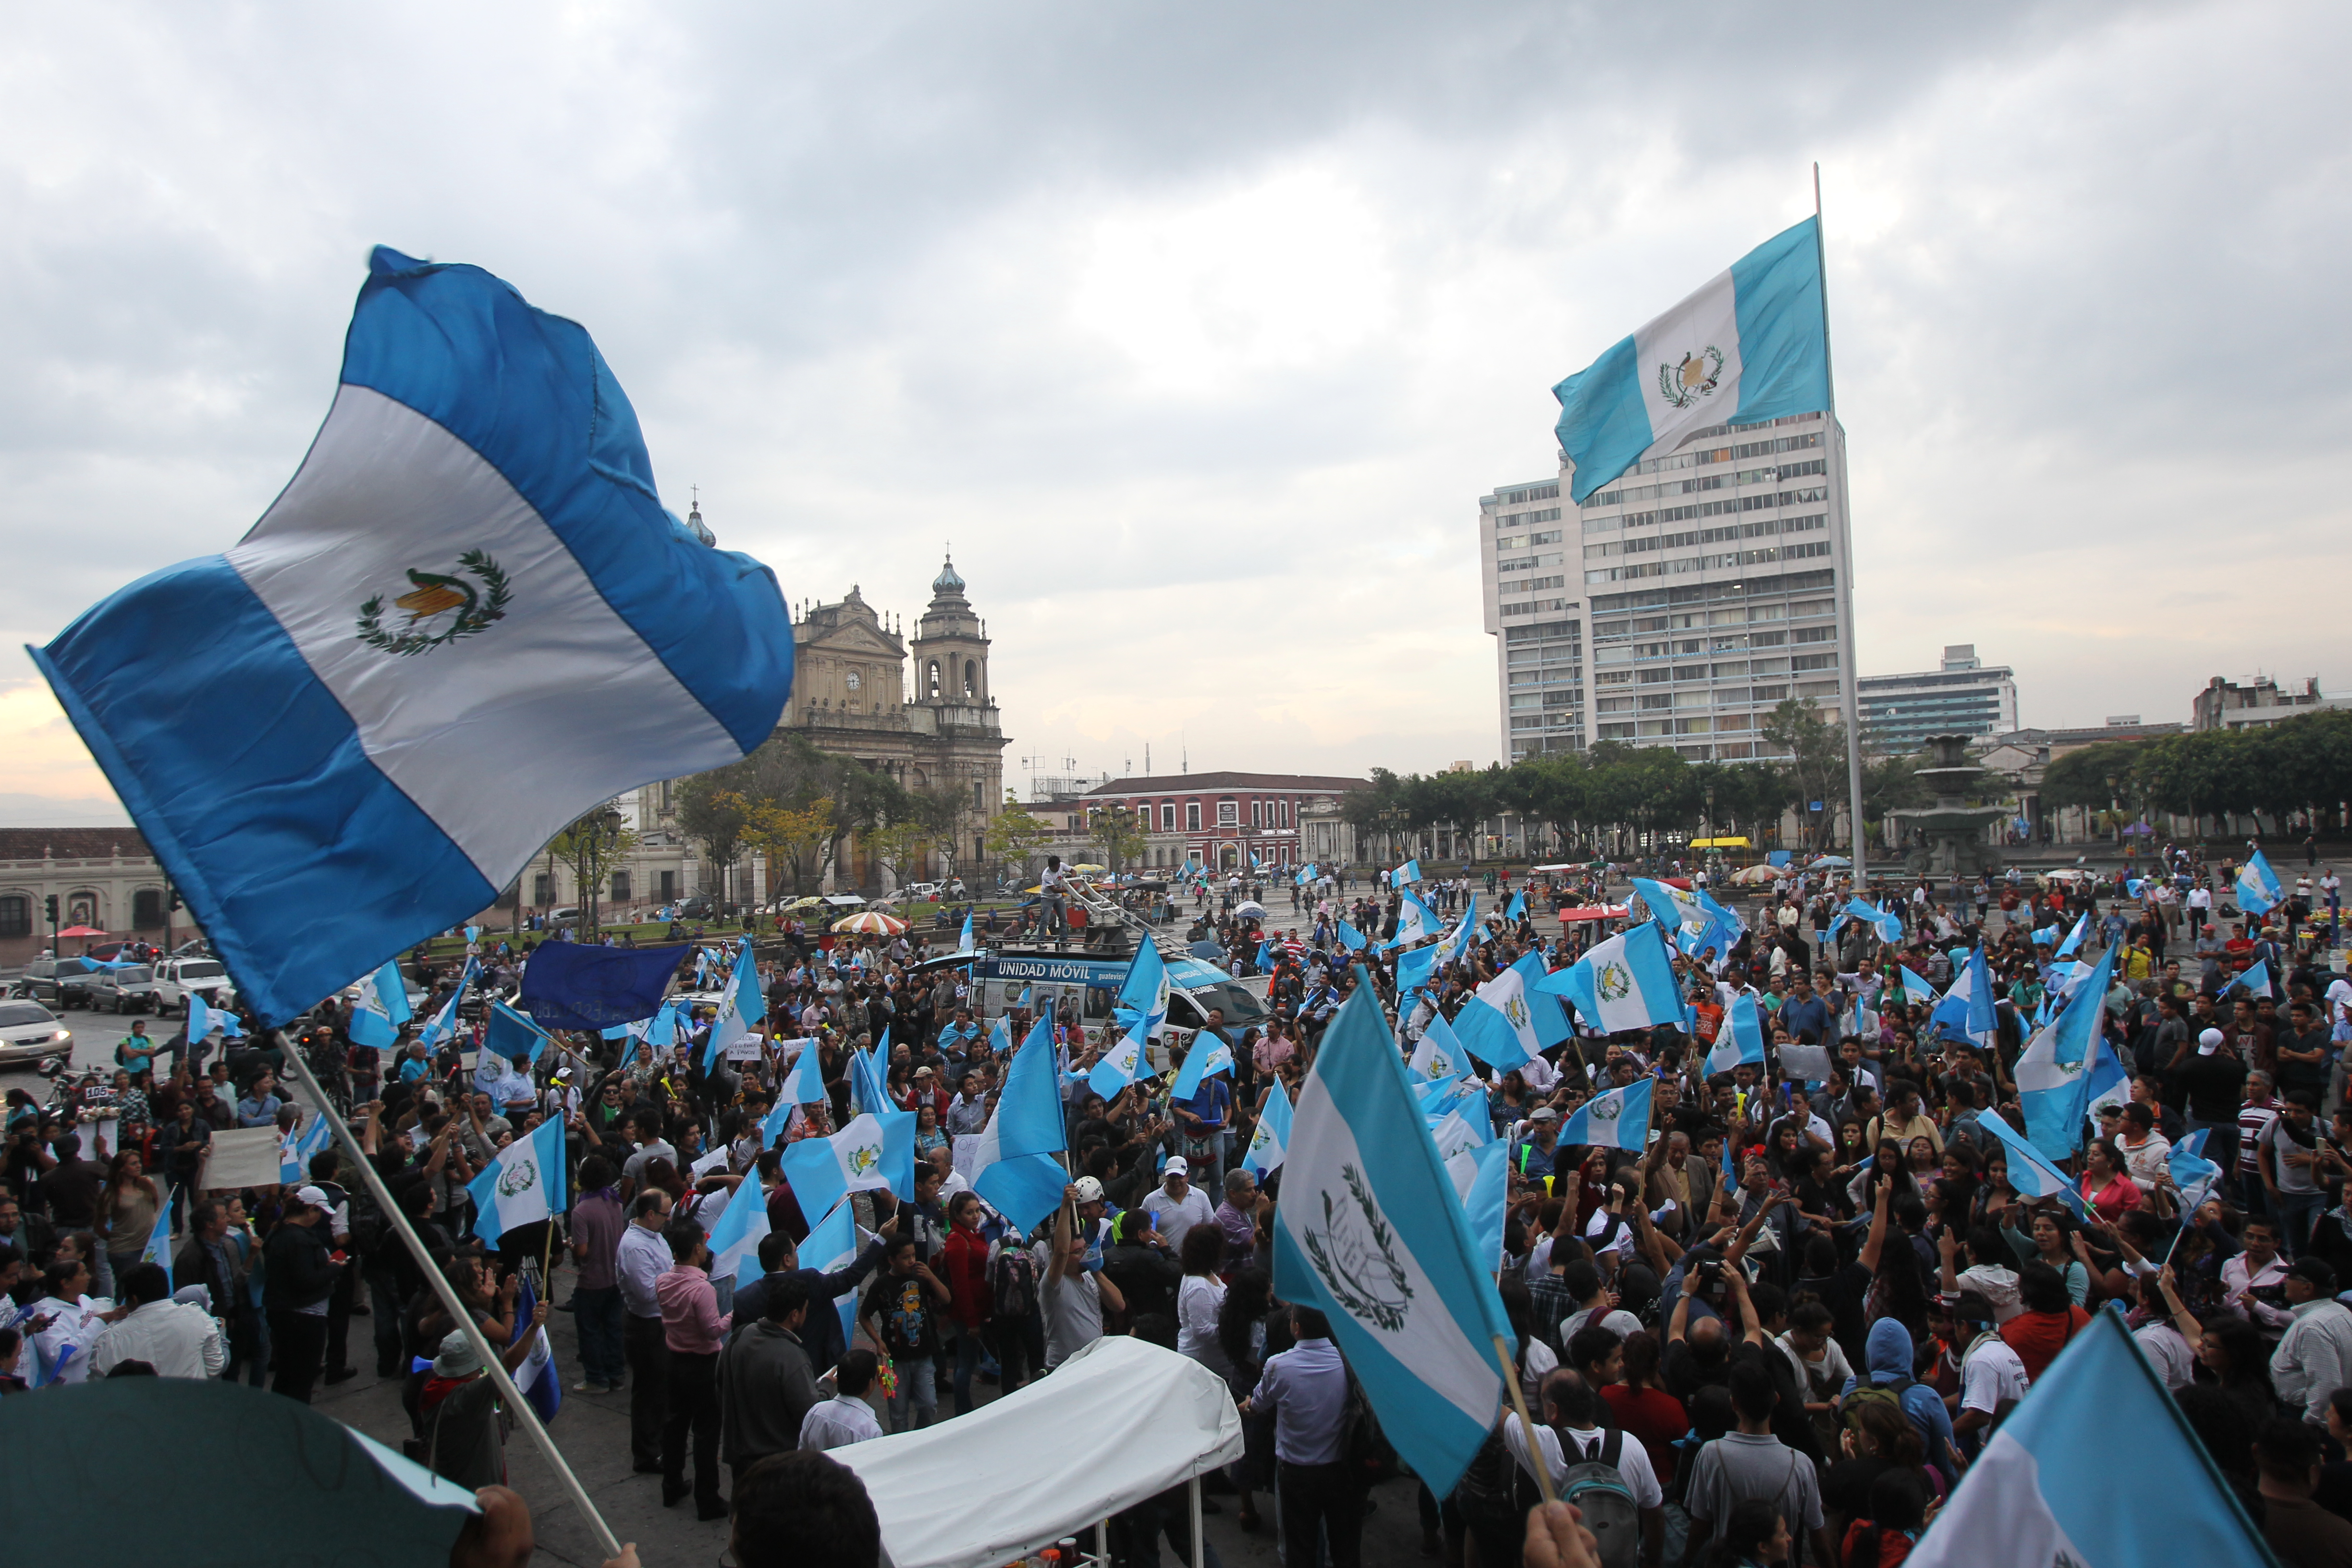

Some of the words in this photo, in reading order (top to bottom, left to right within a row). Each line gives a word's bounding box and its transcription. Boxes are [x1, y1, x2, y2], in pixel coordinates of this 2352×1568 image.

[999, 962, 1046, 977] UNIDAD
[1050, 961, 1090, 979] MÓVIL
[1173, 970, 1202, 980] UNIDAD
